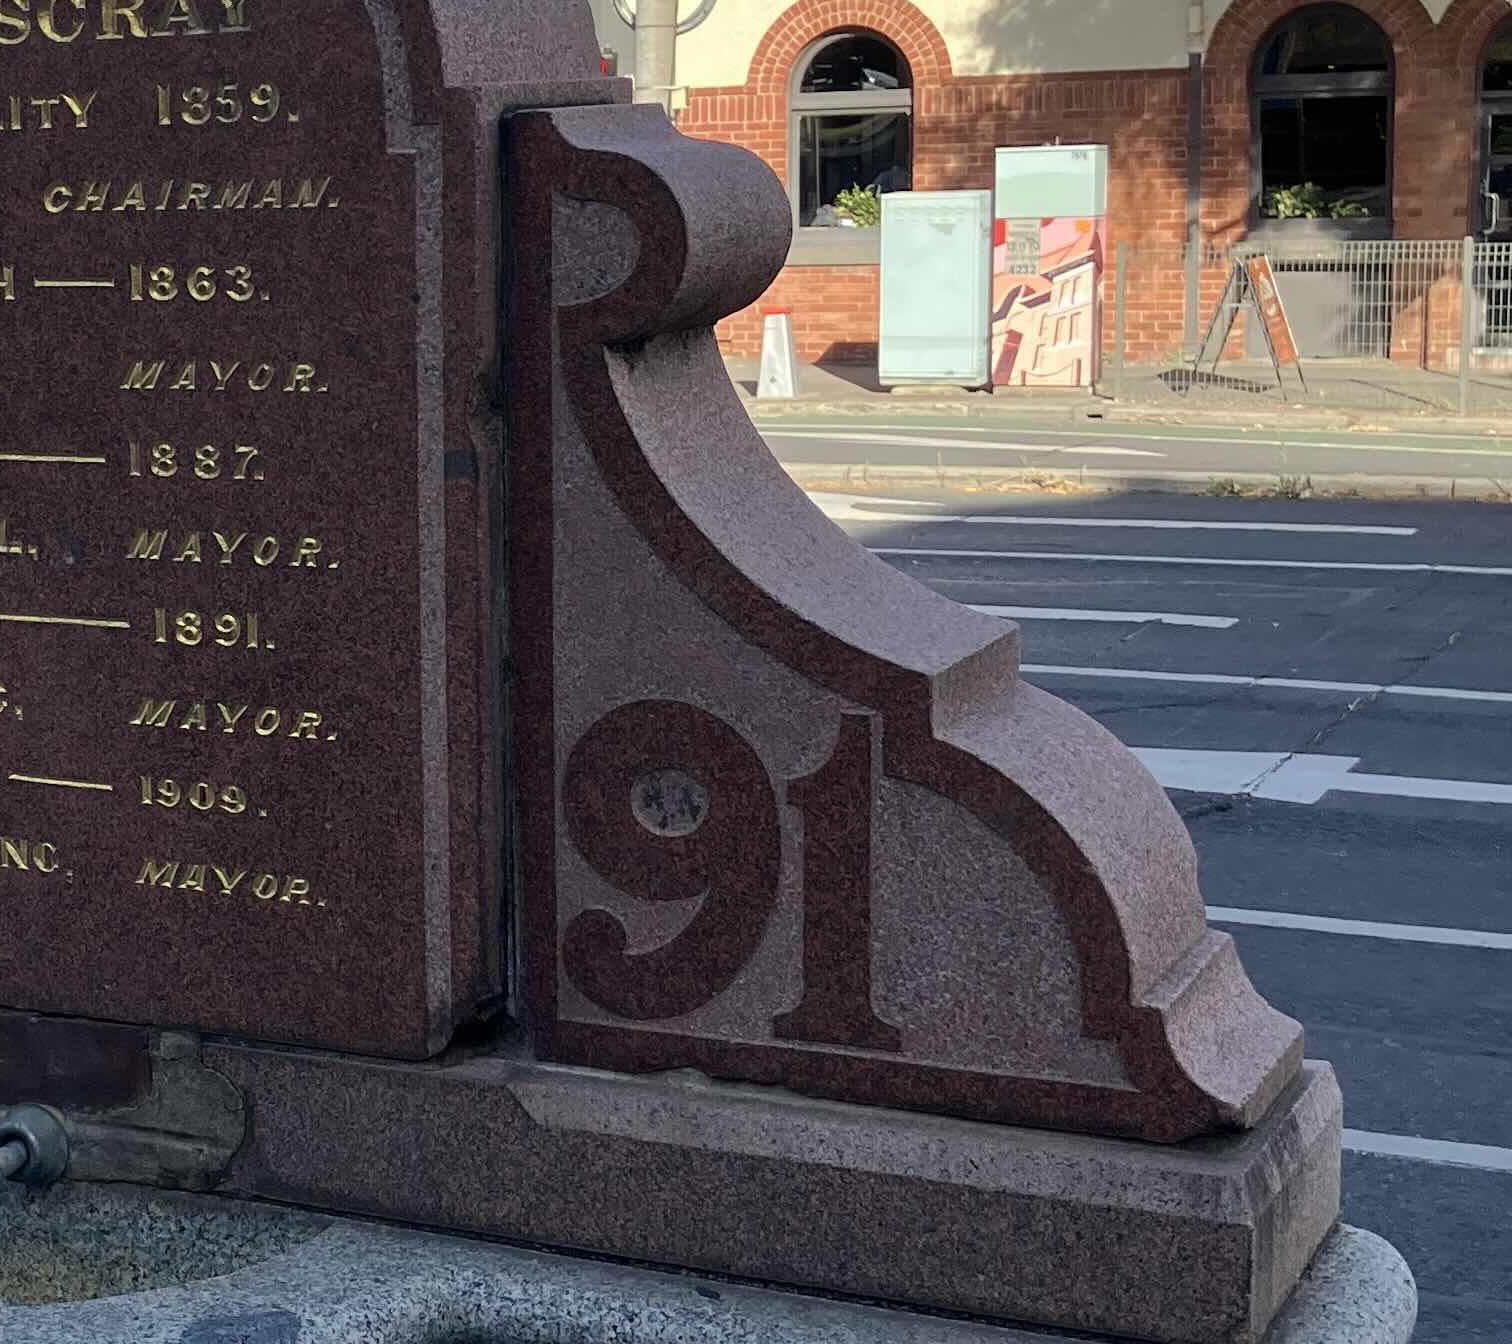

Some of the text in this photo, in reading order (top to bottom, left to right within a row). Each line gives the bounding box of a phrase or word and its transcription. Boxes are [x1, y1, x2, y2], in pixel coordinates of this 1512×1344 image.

[155, 82, 300, 127] 1859.
[42, 177, 343, 213] CHAIRMAN.
[128, 263, 271, 303] 1863.
[120, 359, 330, 394] MAYOR.
[127, 439, 267, 481] 1887.
[126, 527, 342, 569] MAYOR.
[153, 607, 277, 650] 1891.
[128, 698, 339, 742] MAYOR.
[138, 774, 269, 817] 1909.
[135, 857, 328, 908] MAYOR.
[561, 697, 903, 1052] 91
